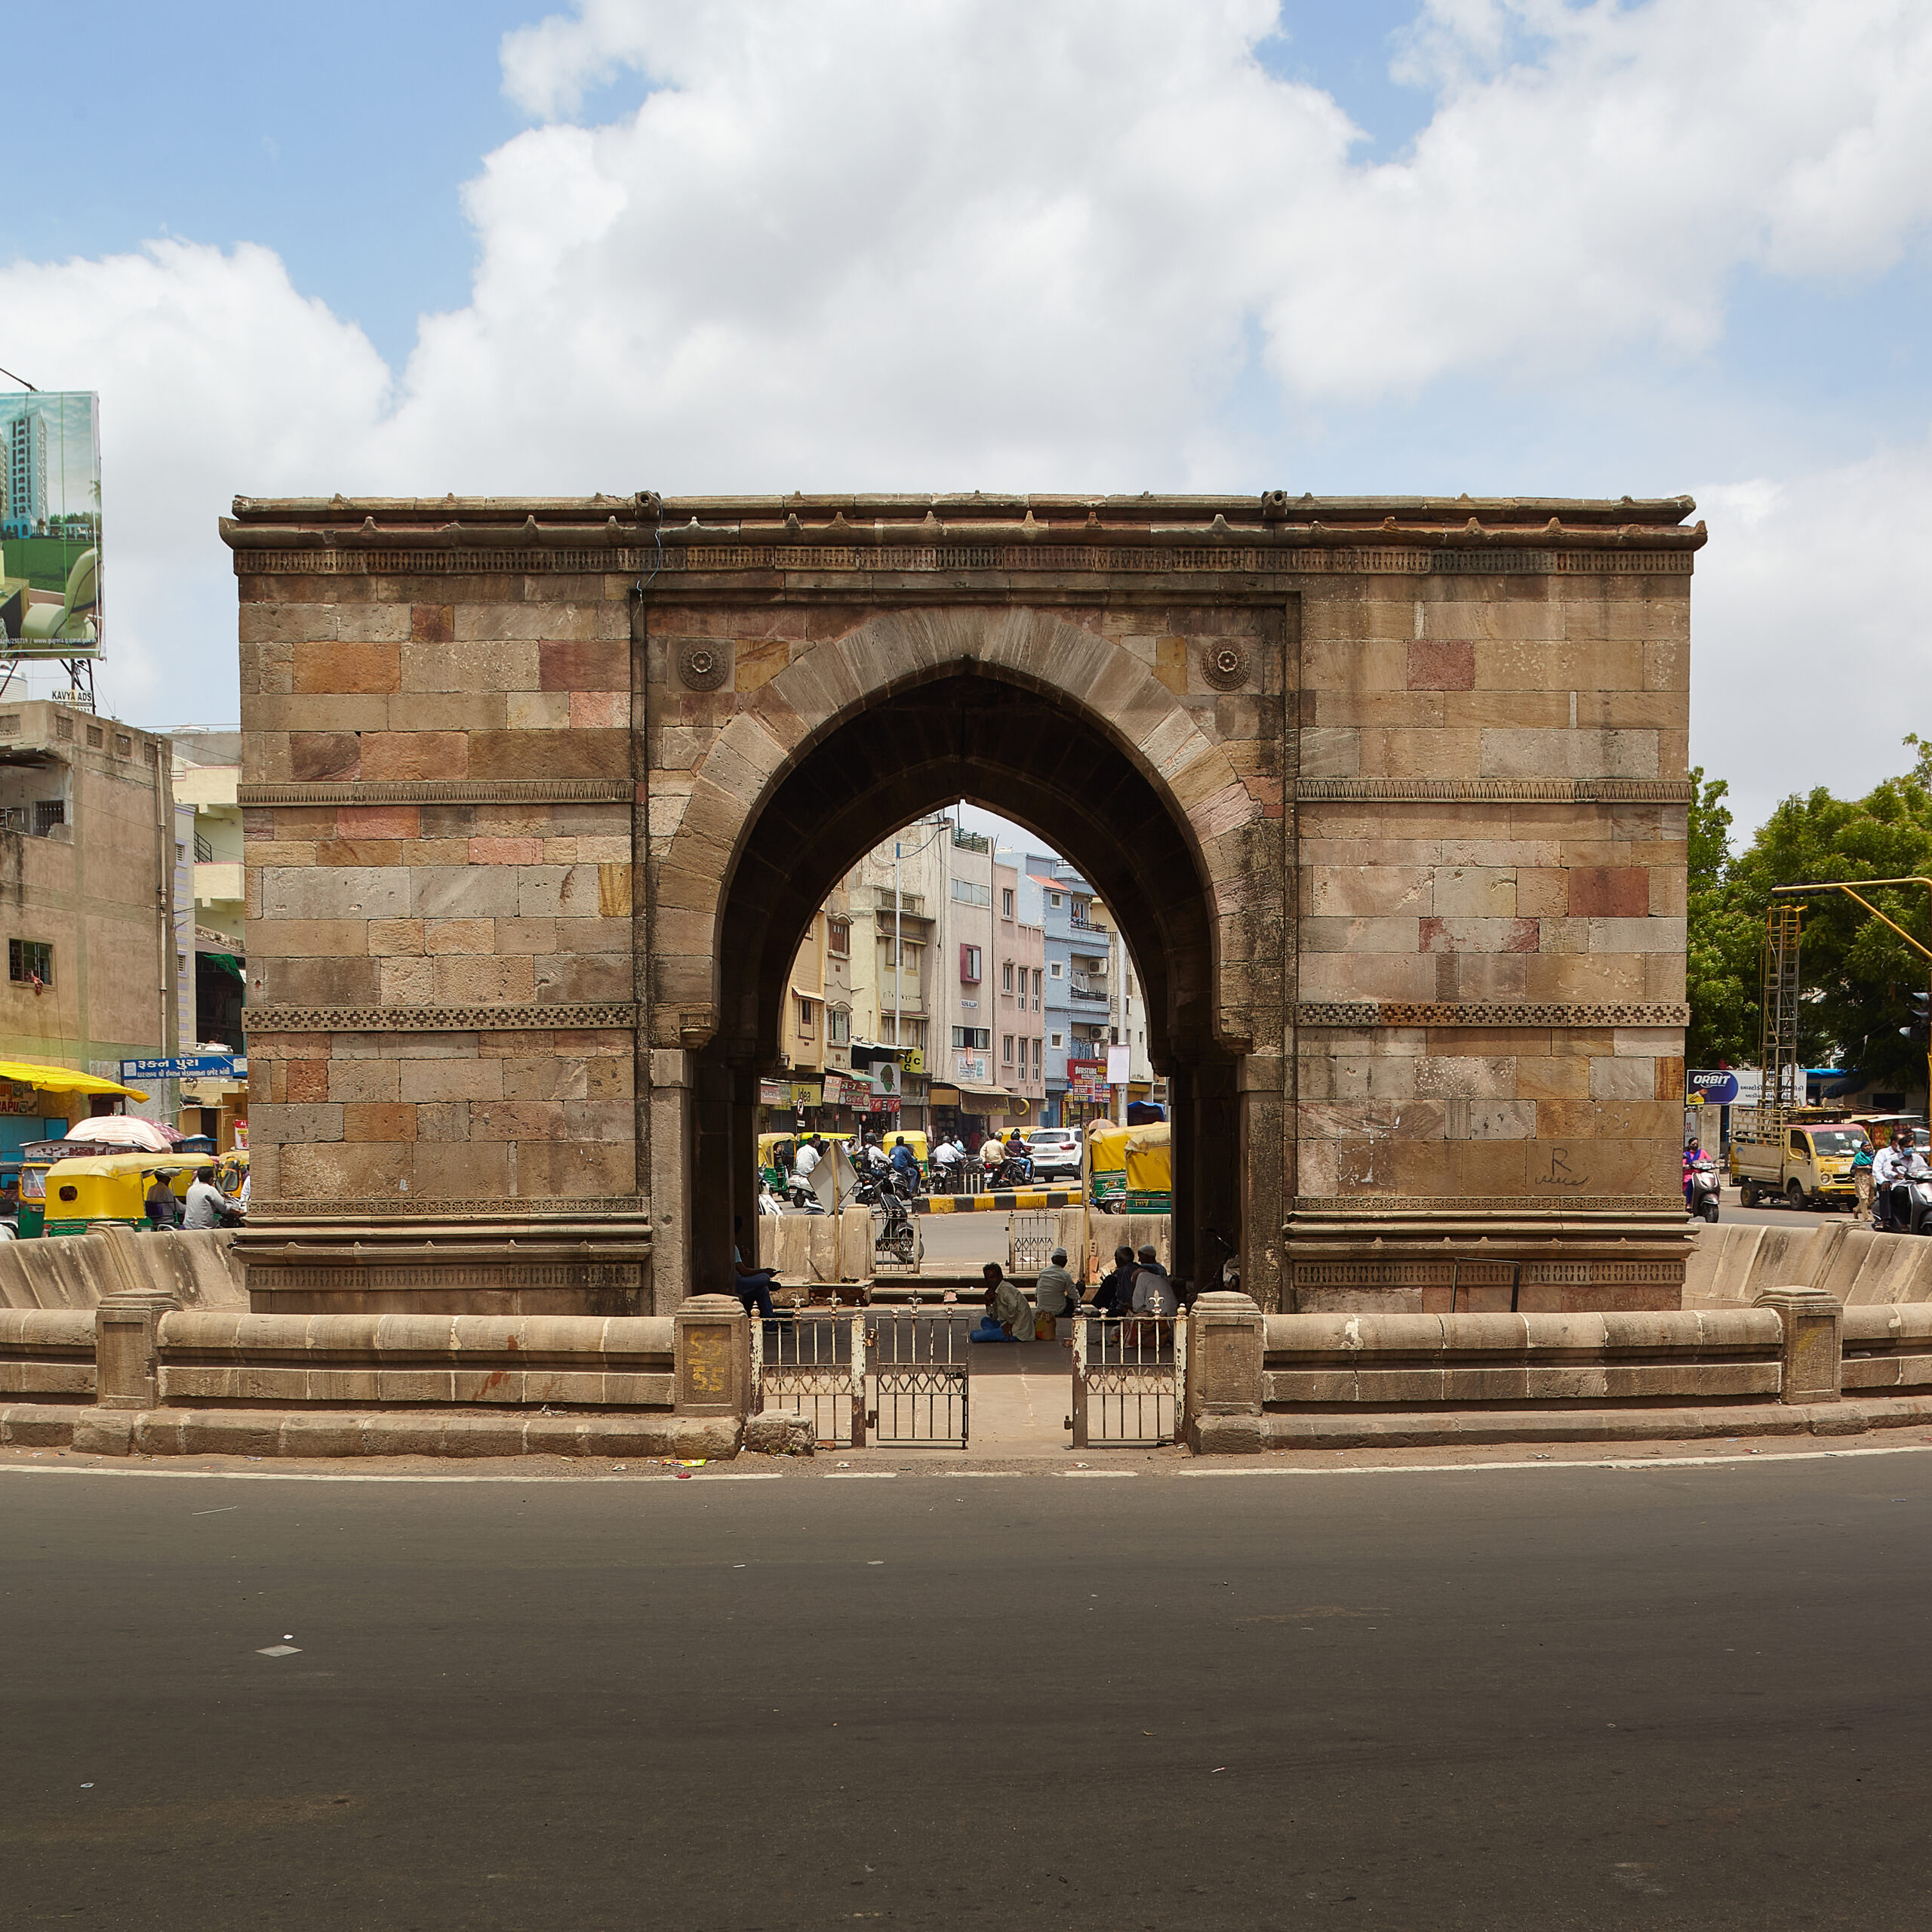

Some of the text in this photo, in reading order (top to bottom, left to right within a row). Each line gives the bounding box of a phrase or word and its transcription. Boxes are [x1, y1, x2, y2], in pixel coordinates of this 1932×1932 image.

[52, 691, 92, 702] KAVYA ADS
[1693, 1075, 1730, 1084] ORBIT
[798, 1088, 811, 1103] Idea
[0, 1101, 19, 1112] APU
[1552, 1147, 1572, 1176] R
